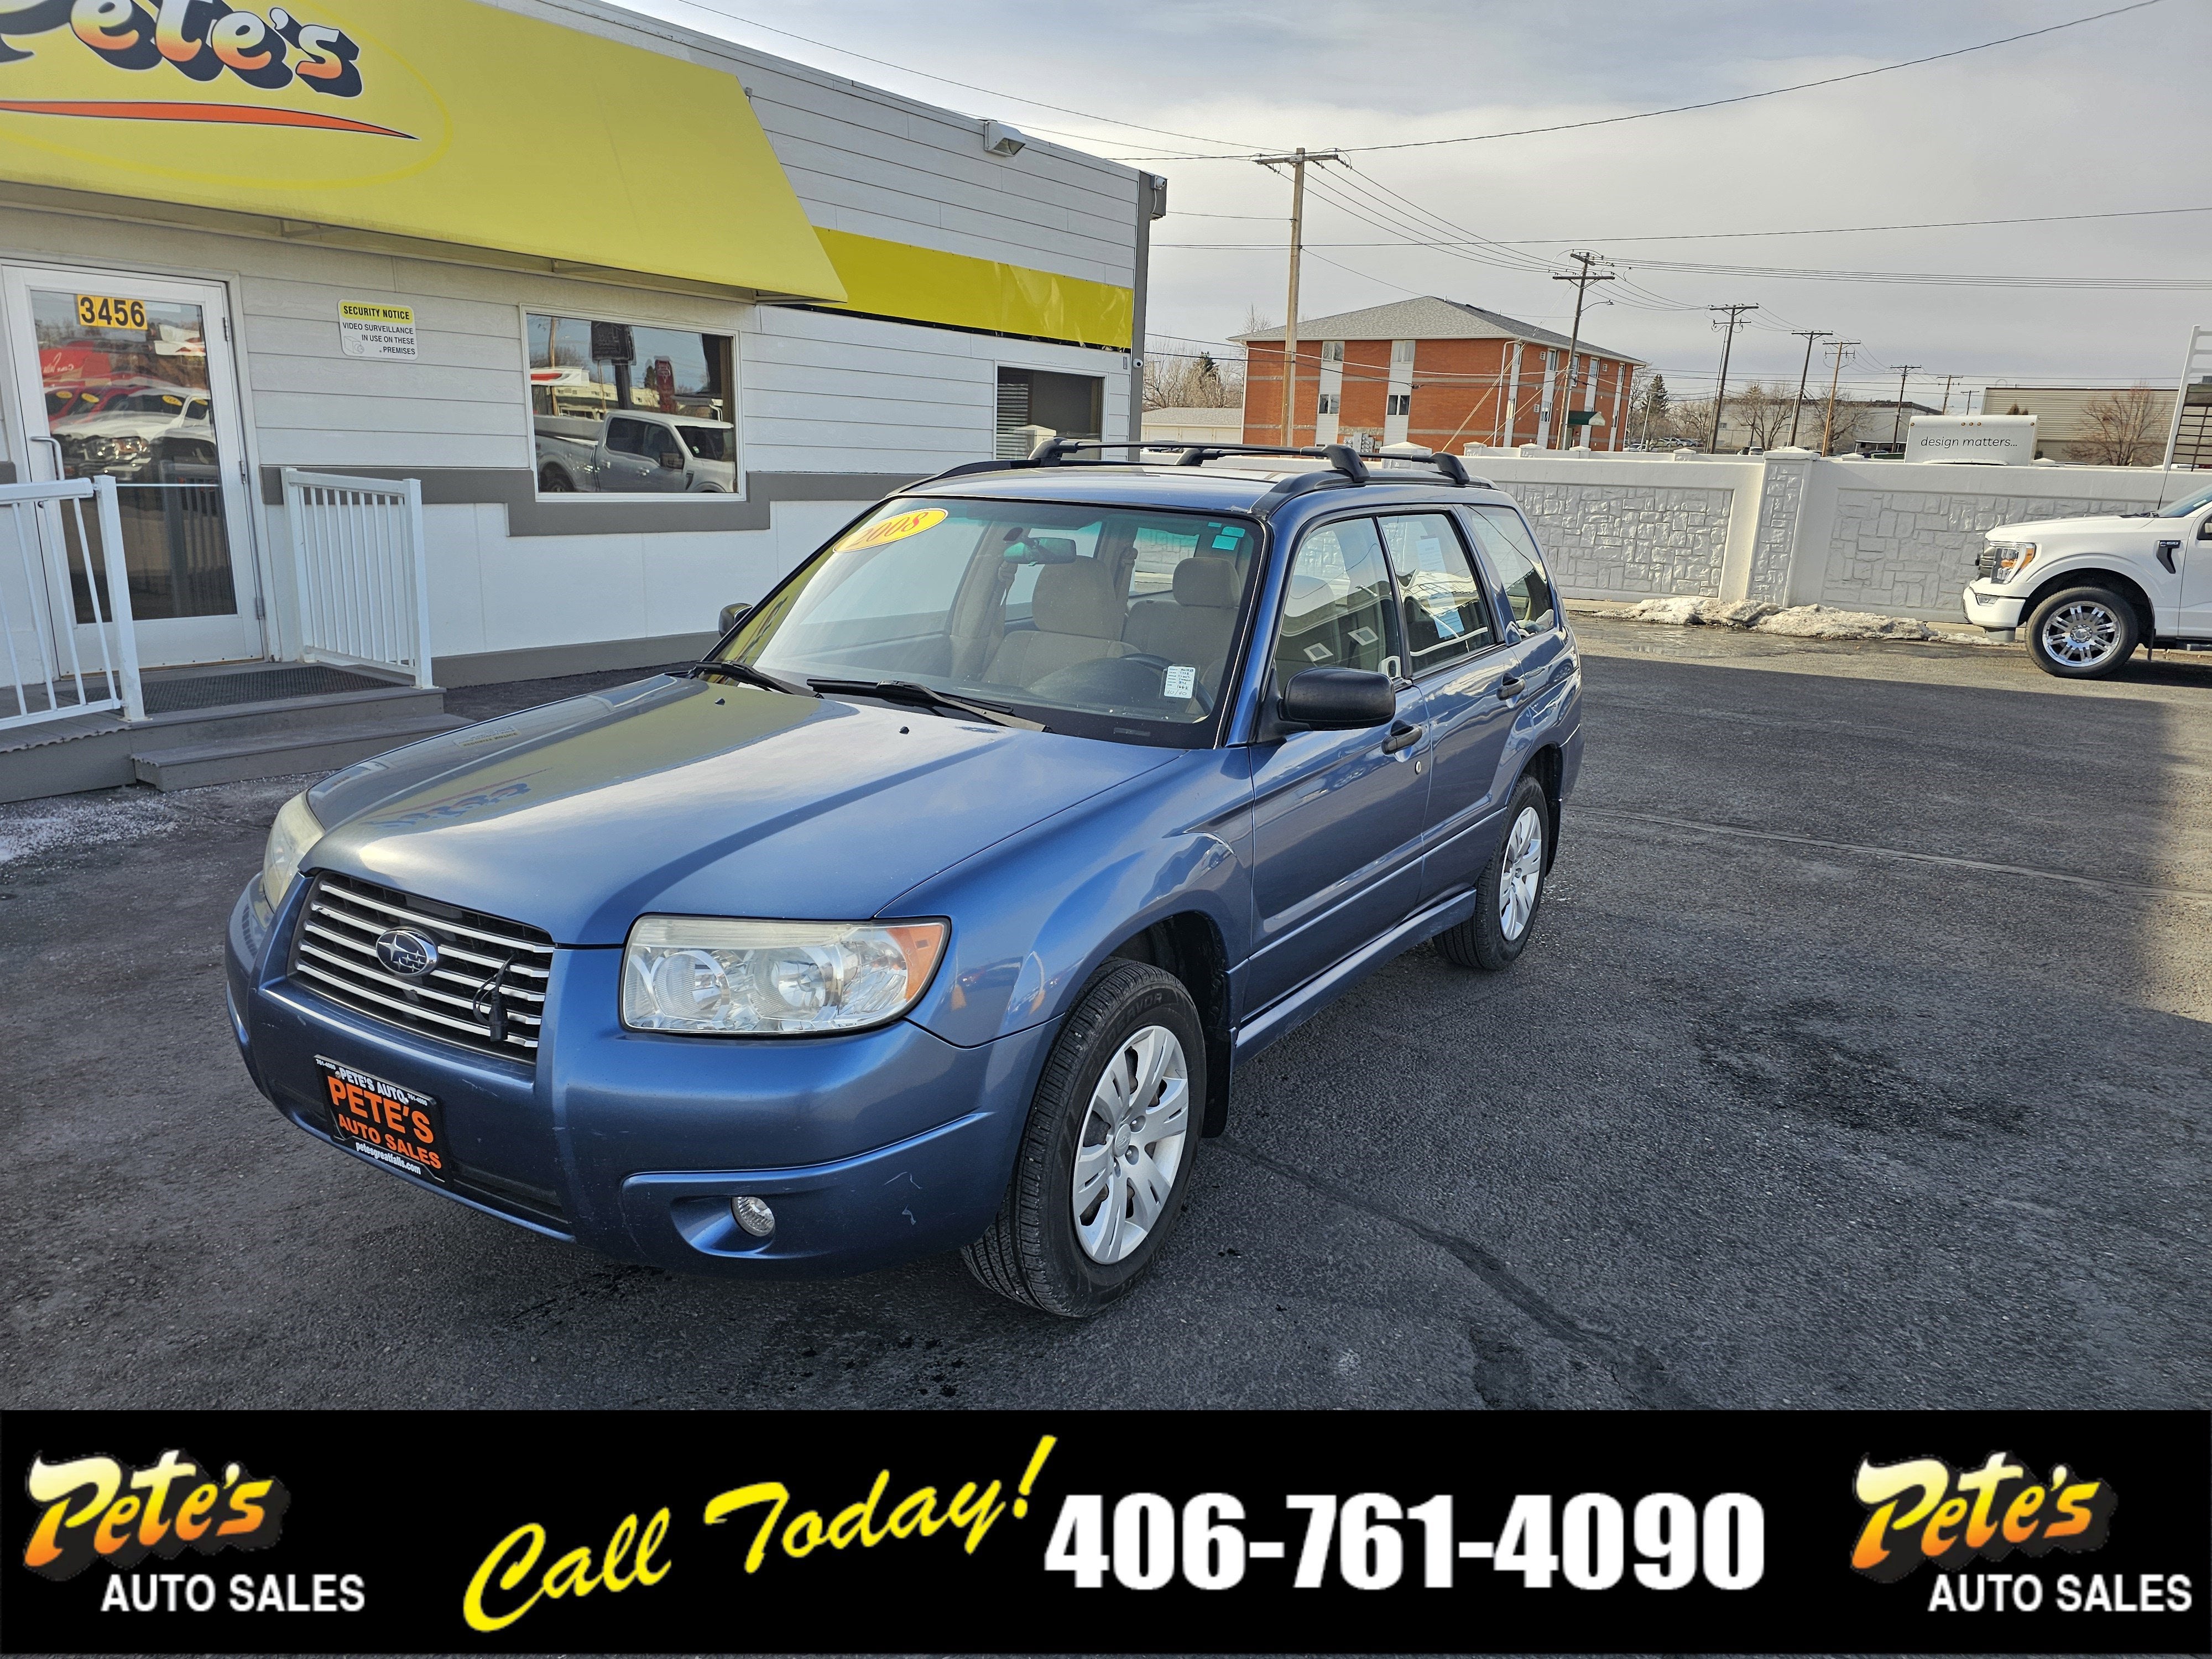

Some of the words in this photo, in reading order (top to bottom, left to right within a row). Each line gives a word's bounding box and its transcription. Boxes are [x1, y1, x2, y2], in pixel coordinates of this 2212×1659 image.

[0, 0, 354, 91] ete's
[80, 296, 145, 327] 3456
[343, 305, 380, 317] SECURITY
[383, 309, 410, 320] NOTICE
[342, 322, 363, 330] VIDEO
[364, 324, 414, 335] SURVEILLANCE
[383, 346, 415, 355] PREMISES
[1921, 436, 1959, 449] design
[1962, 437, 2017, 447] matters...
[844, 512, 929, 549] 2008
[339, 1067, 375, 1092] PETE'S
[377, 1081, 406, 1104] AUTO
[327, 1076, 434, 1143] PETE'S
[338, 1113, 381, 1144] AUTO
[384, 1134, 442, 1169] SALES
[355, 1142, 421, 1175] petesgreatfalls.com
